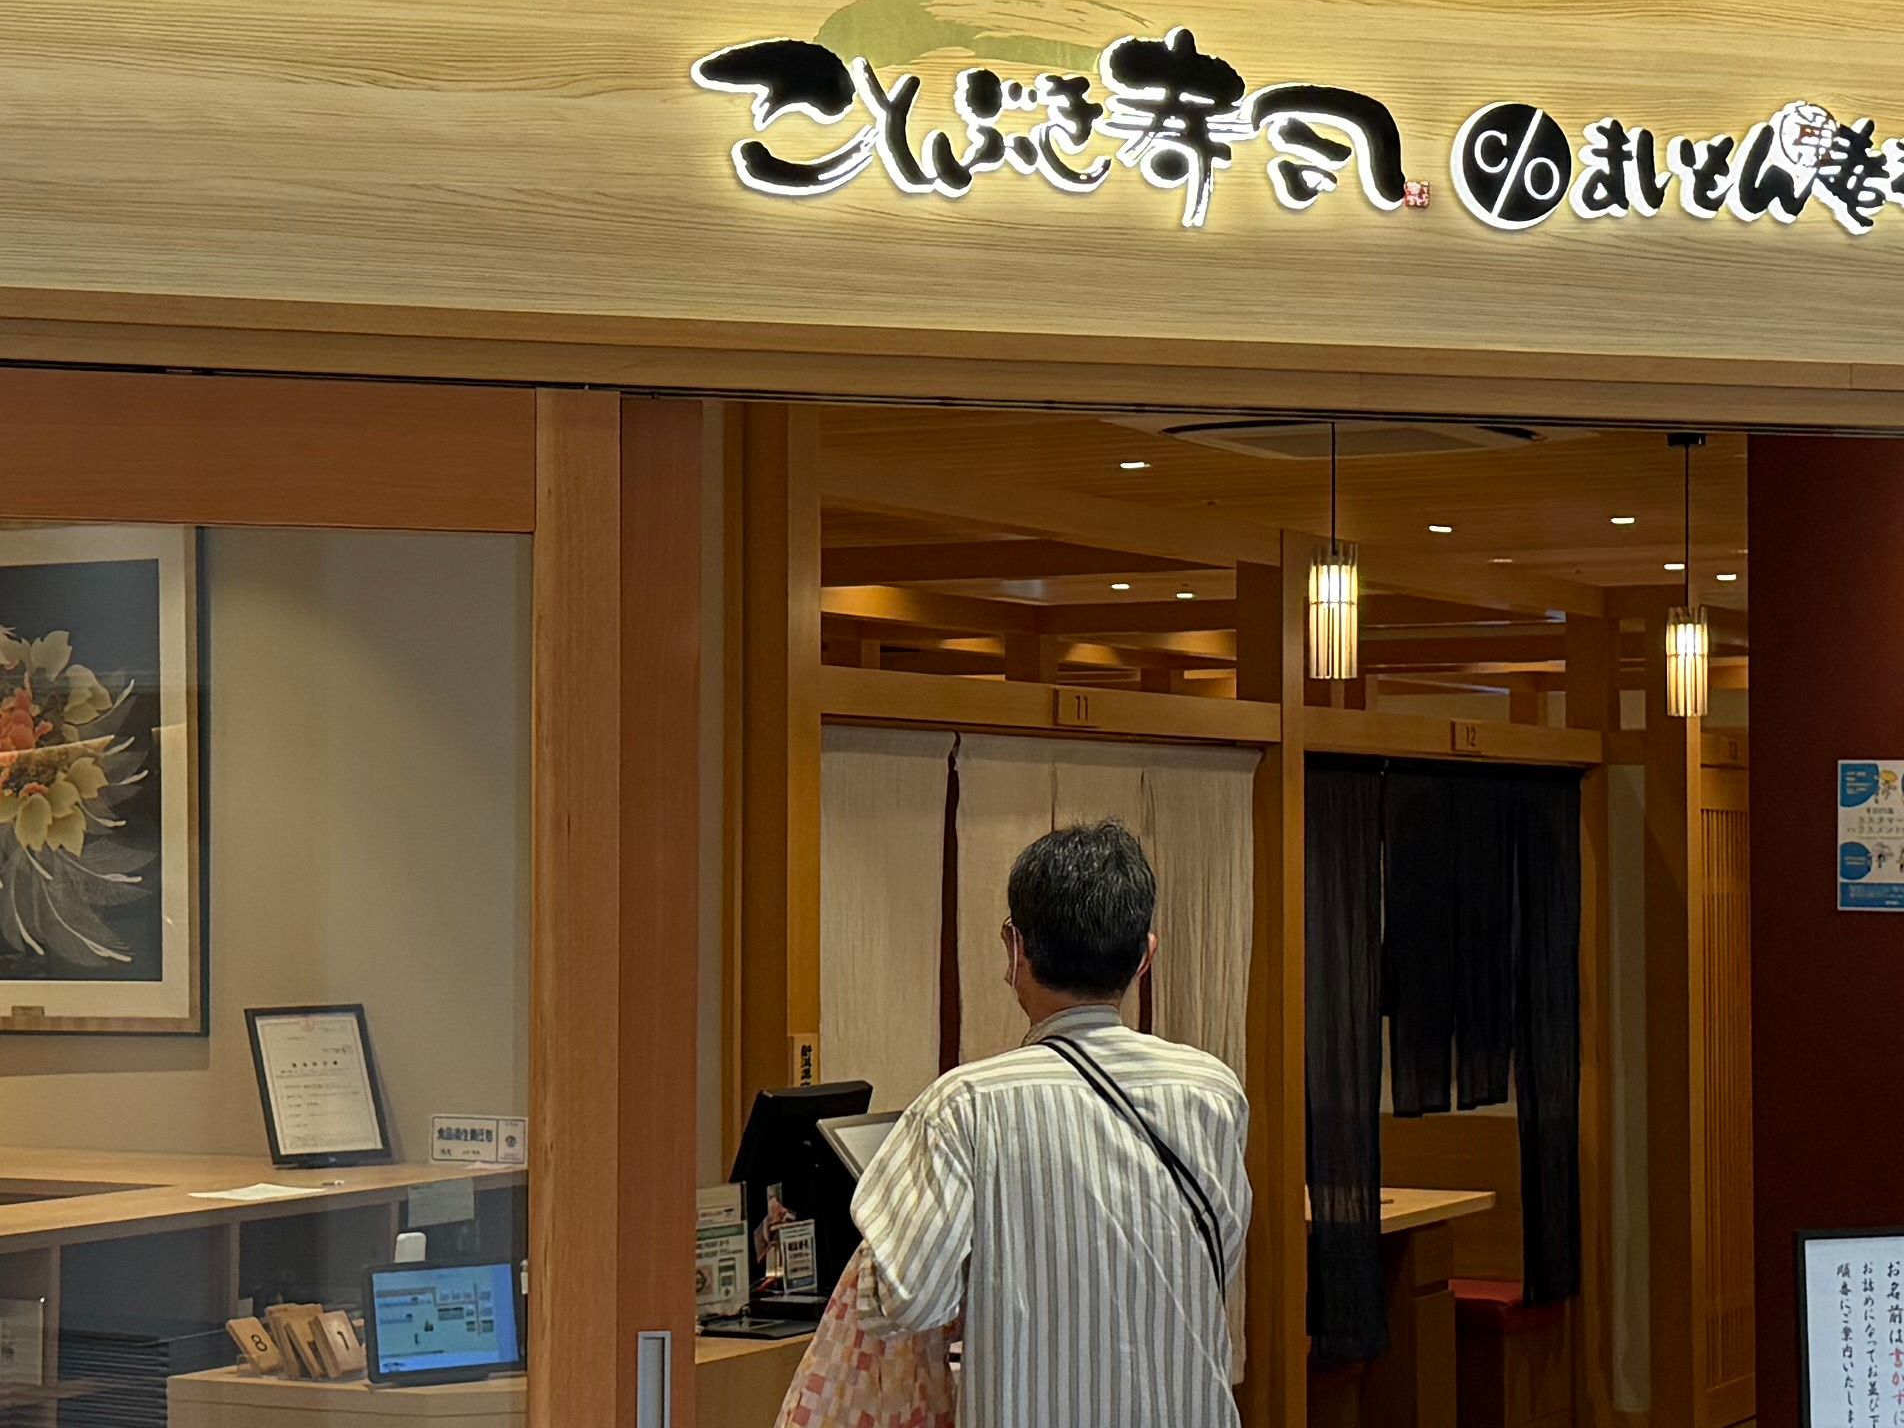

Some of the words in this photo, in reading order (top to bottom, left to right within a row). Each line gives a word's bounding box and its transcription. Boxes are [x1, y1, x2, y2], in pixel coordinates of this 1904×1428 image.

[694, 27, 1405, 226] ことぶき寿司
[1076, 695, 1088, 721] 11
[251, 1334, 267, 1352] 8
[337, 1330, 349, 1350] 1
